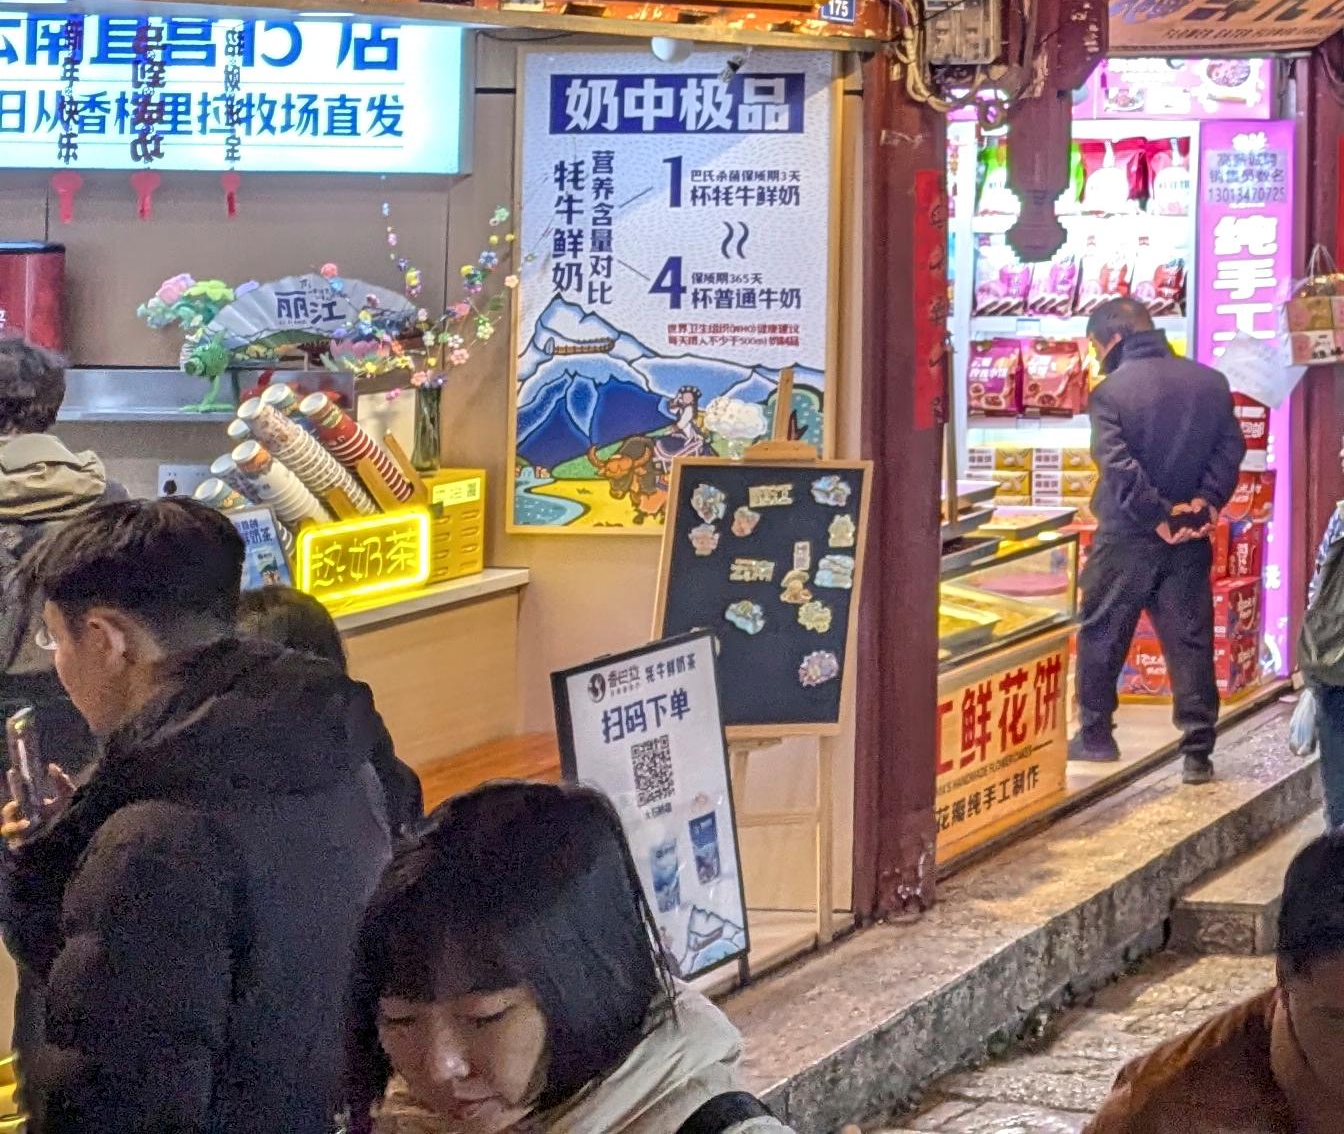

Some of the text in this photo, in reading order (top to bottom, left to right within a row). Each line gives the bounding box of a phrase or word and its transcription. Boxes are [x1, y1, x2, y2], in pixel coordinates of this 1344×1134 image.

[828, 0, 850, 18] 175
[564, 77, 790, 132] 奶中极品
[662, 155, 683, 208] 1
[690, 169, 801, 183] 巴氏杀菌保质期3天
[690, 185, 801, 208] 杯牦牛鲜奶
[552, 159, 585, 294] 牦牛鲜奶
[588, 150, 615, 306] 营养含量对比
[648, 256, 687, 310] 4
[691, 272, 763, 285] 保质期365天
[691, 288, 802, 310] 杯普通牛奶
[1212, 215, 1278, 358] 纯手工
[275, 290, 346, 325] 丽江
[311, 529, 419, 588] 热奶茶
[602, 687, 691, 744] 扫码下单
